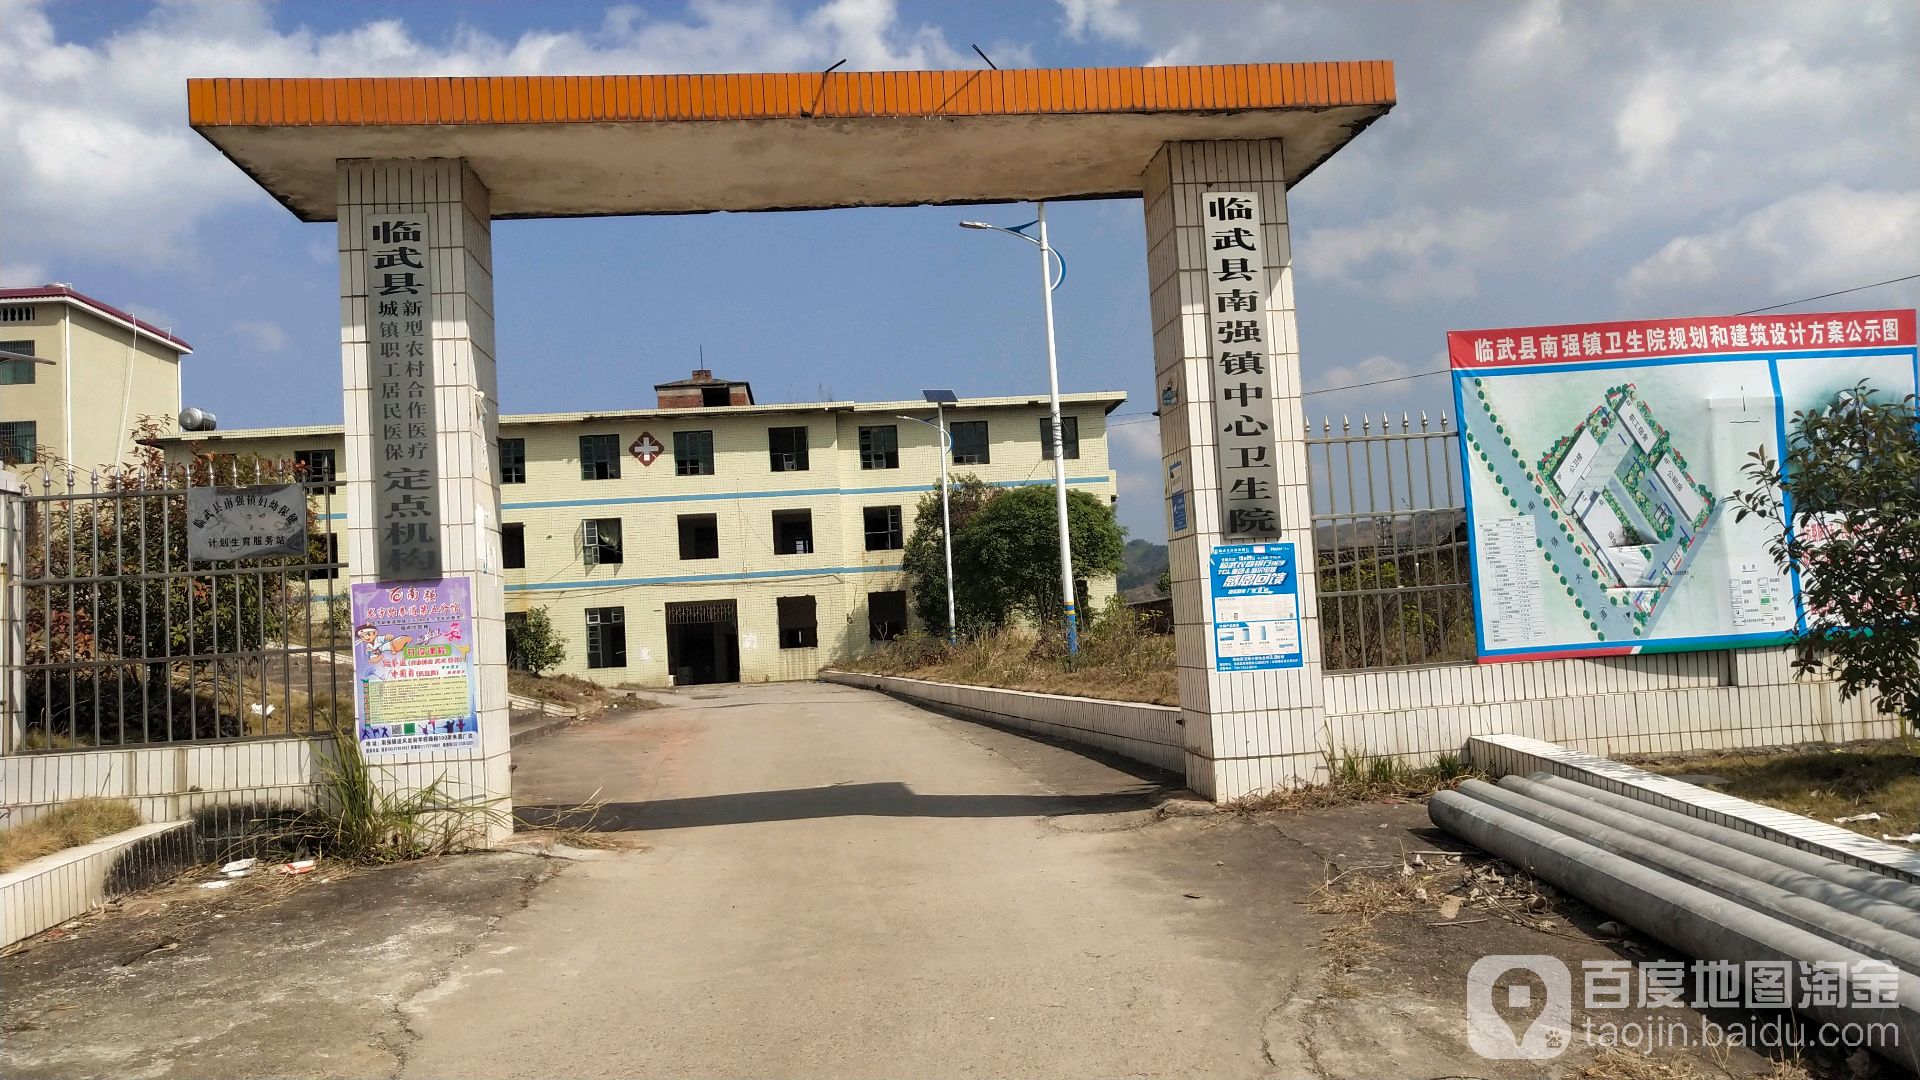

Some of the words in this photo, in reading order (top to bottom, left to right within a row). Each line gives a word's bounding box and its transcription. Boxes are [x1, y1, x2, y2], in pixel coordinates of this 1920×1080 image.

[372, 221, 424, 296] 临武县
[378, 300, 404, 461] 城镇职工居民医保
[401, 299, 429, 461] 新型农村合作医疗
[1208, 196, 1278, 535] 临武县南强镇中心卫生院
[1474, 318, 1900, 362] 临武县南强镇卫生院规划和建筑设计方案公示图
[208, 534, 285, 548] 计划生育服务站
[382, 467, 437, 573] 定点机构
